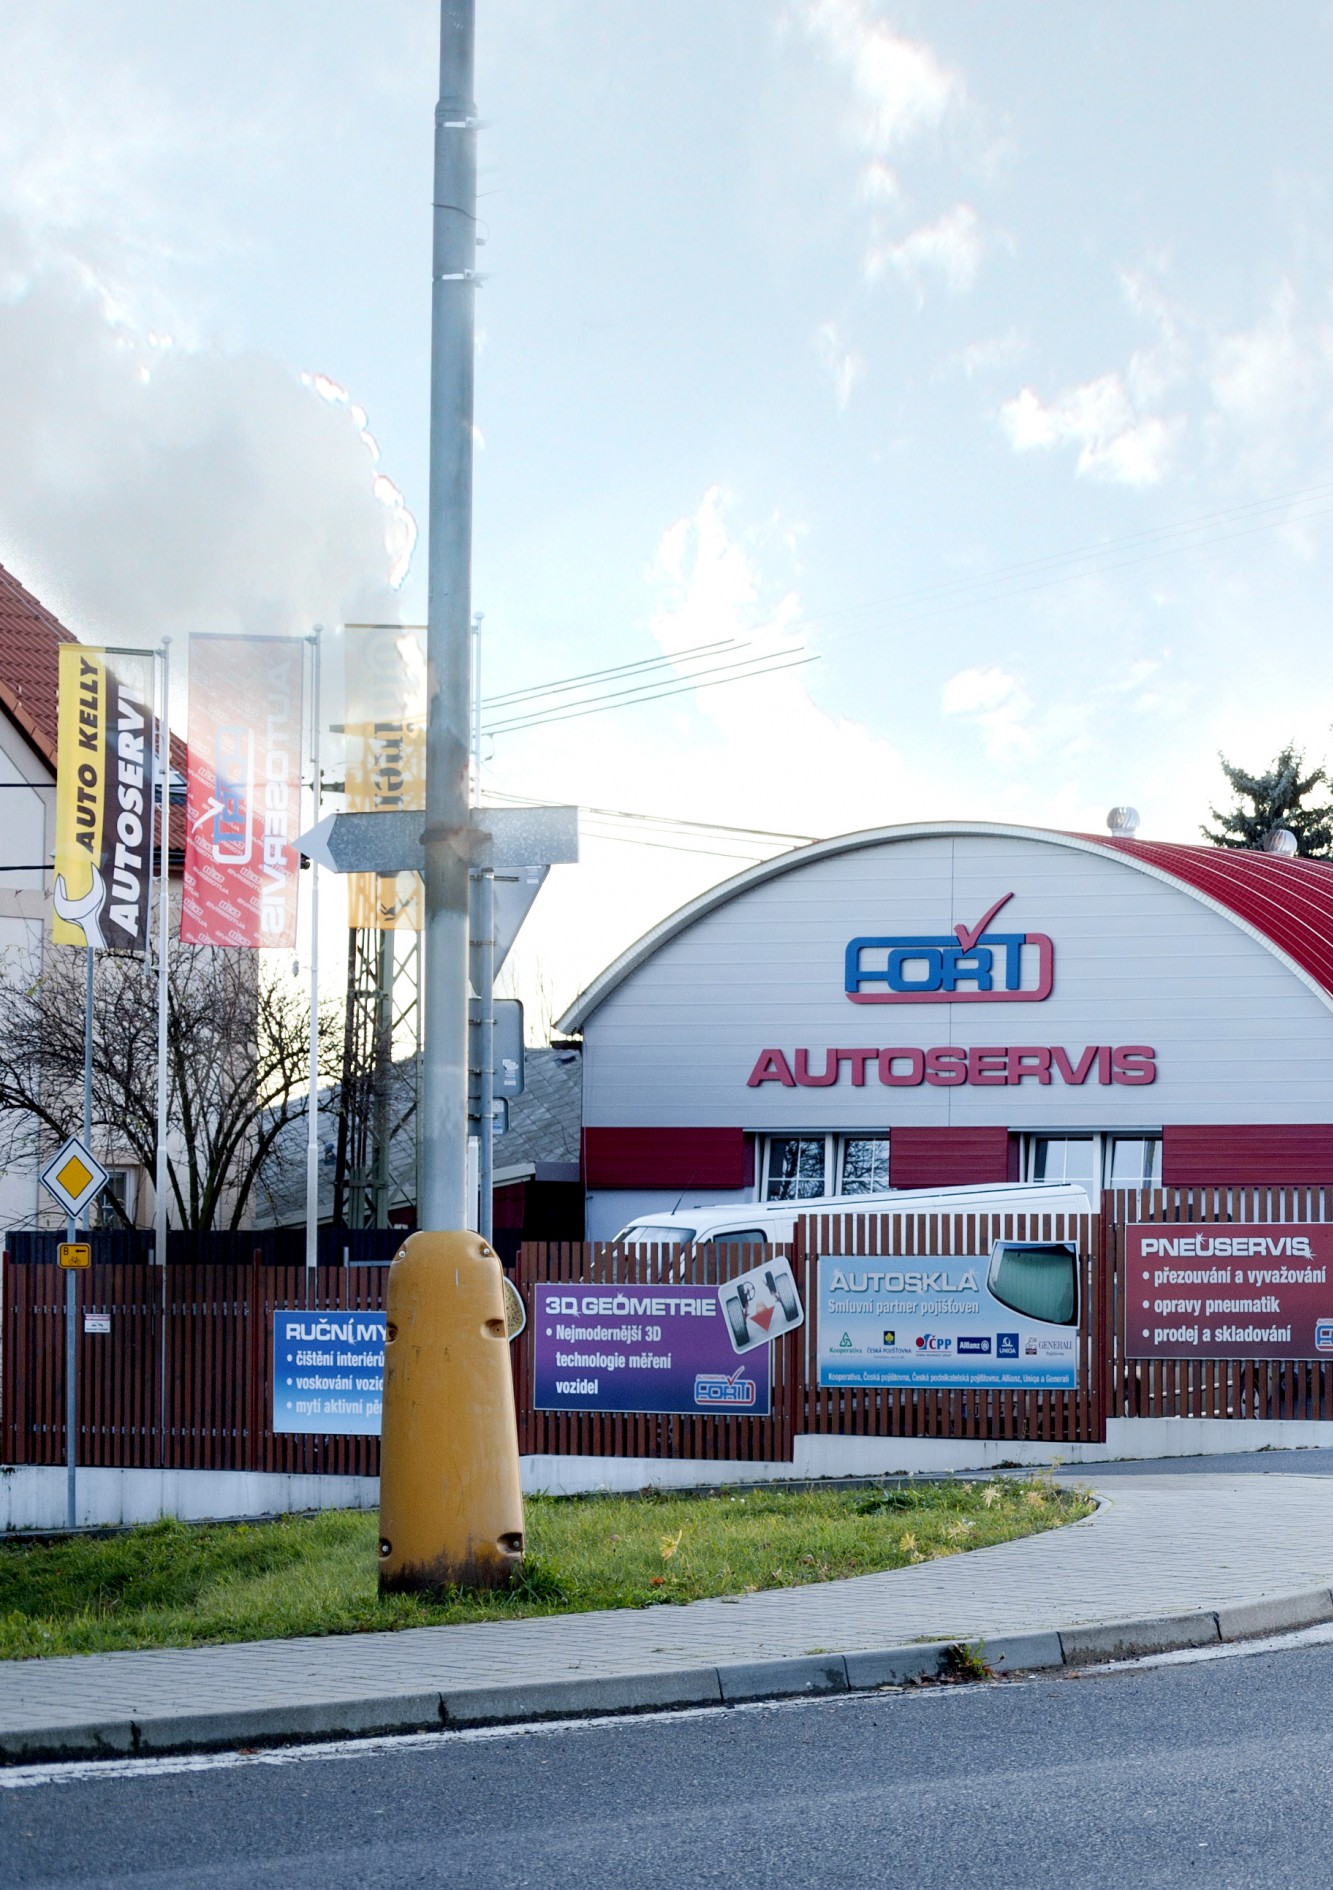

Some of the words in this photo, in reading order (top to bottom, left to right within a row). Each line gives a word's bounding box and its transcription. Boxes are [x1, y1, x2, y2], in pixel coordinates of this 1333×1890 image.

[79, 656, 99, 752] KELLY
[76, 764, 97, 856] AUTO
[845, 933, 1040, 997] FORT
[746, 1045, 1157, 1087] AUTOSERVIS
[64, 1247, 68, 1255] B
[1141, 1237, 1310, 1258] PNEUSERVIS
[829, 1270, 980, 1293] AUTOSKLA
[1154, 1266, 1231, 1287] přezouvání
[1235, 1271, 1243, 1284] a
[1247, 1266, 1326, 1286] vyvažování
[546, 1297, 578, 1316] 3D
[582, 1296, 716, 1316] GEOMETRIE
[828, 1300, 875, 1314] Smluvní
[877, 1301, 919, 1316] partner
[921, 1299, 979, 1316] pojišťoven
[1154, 1300, 1201, 1316] opravy
[1206, 1296, 1280, 1316] pneumatik
[286, 1318, 354, 1344] RUČNÍ
[556, 1325, 642, 1344] Nejmodernější
[646, 1327, 662, 1341] 3D
[1154, 1326, 1198, 1345] prodej
[1203, 1330, 1211, 1342] a
[1215, 1325, 1291, 1342] skladování
[929, 1335, 951, 1350] ČPP
[960, 1341, 980, 1349] Allianz
[1039, 1341, 1072, 1350] GENERALI
[296, 1350, 334, 1366] čištění
[337, 1351, 384, 1367] interiérů
[556, 1352, 625, 1370] technologie
[629, 1353, 671, 1369] měření
[296, 1375, 353, 1390] voskování
[556, 1379, 598, 1394] vozidel
[696, 1381, 752, 1402] FORT
[296, 1398, 321, 1416] mytí
[324, 1399, 363, 1414] aktivní
